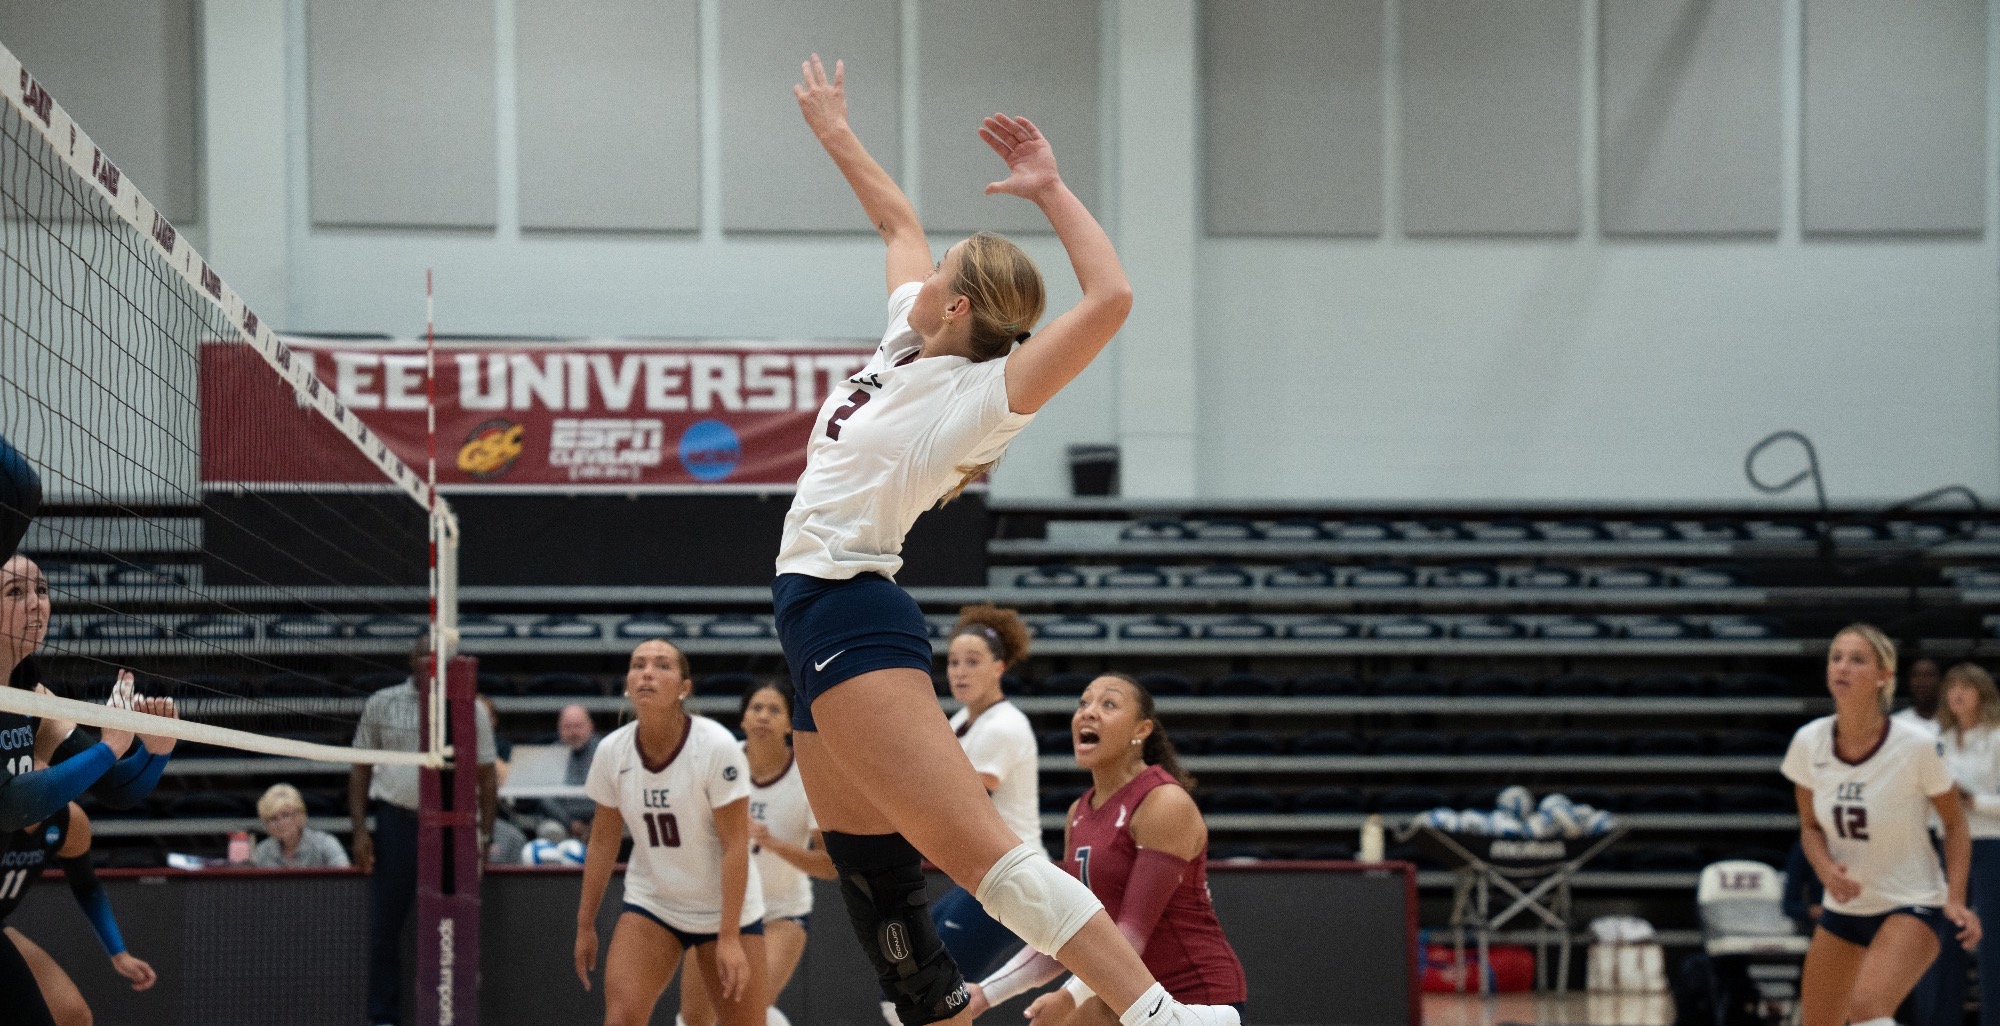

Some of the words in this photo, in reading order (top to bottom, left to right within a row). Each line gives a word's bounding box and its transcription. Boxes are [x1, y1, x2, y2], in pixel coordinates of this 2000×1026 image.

[455, 353, 875, 411] UNIVERSIT
[826, 388, 871, 442] 2
[552, 418, 663, 449] ESPN
[0, 725, 33, 750] COTS
[643, 789, 670, 808] LEE
[1837, 782, 1865, 801] LEE
[751, 802, 767, 820] EE
[1832, 804, 1869, 841] 12
[643, 813, 681, 847] 10
[0, 869, 27, 899] 11
[1718, 871, 1762, 890] LEE
